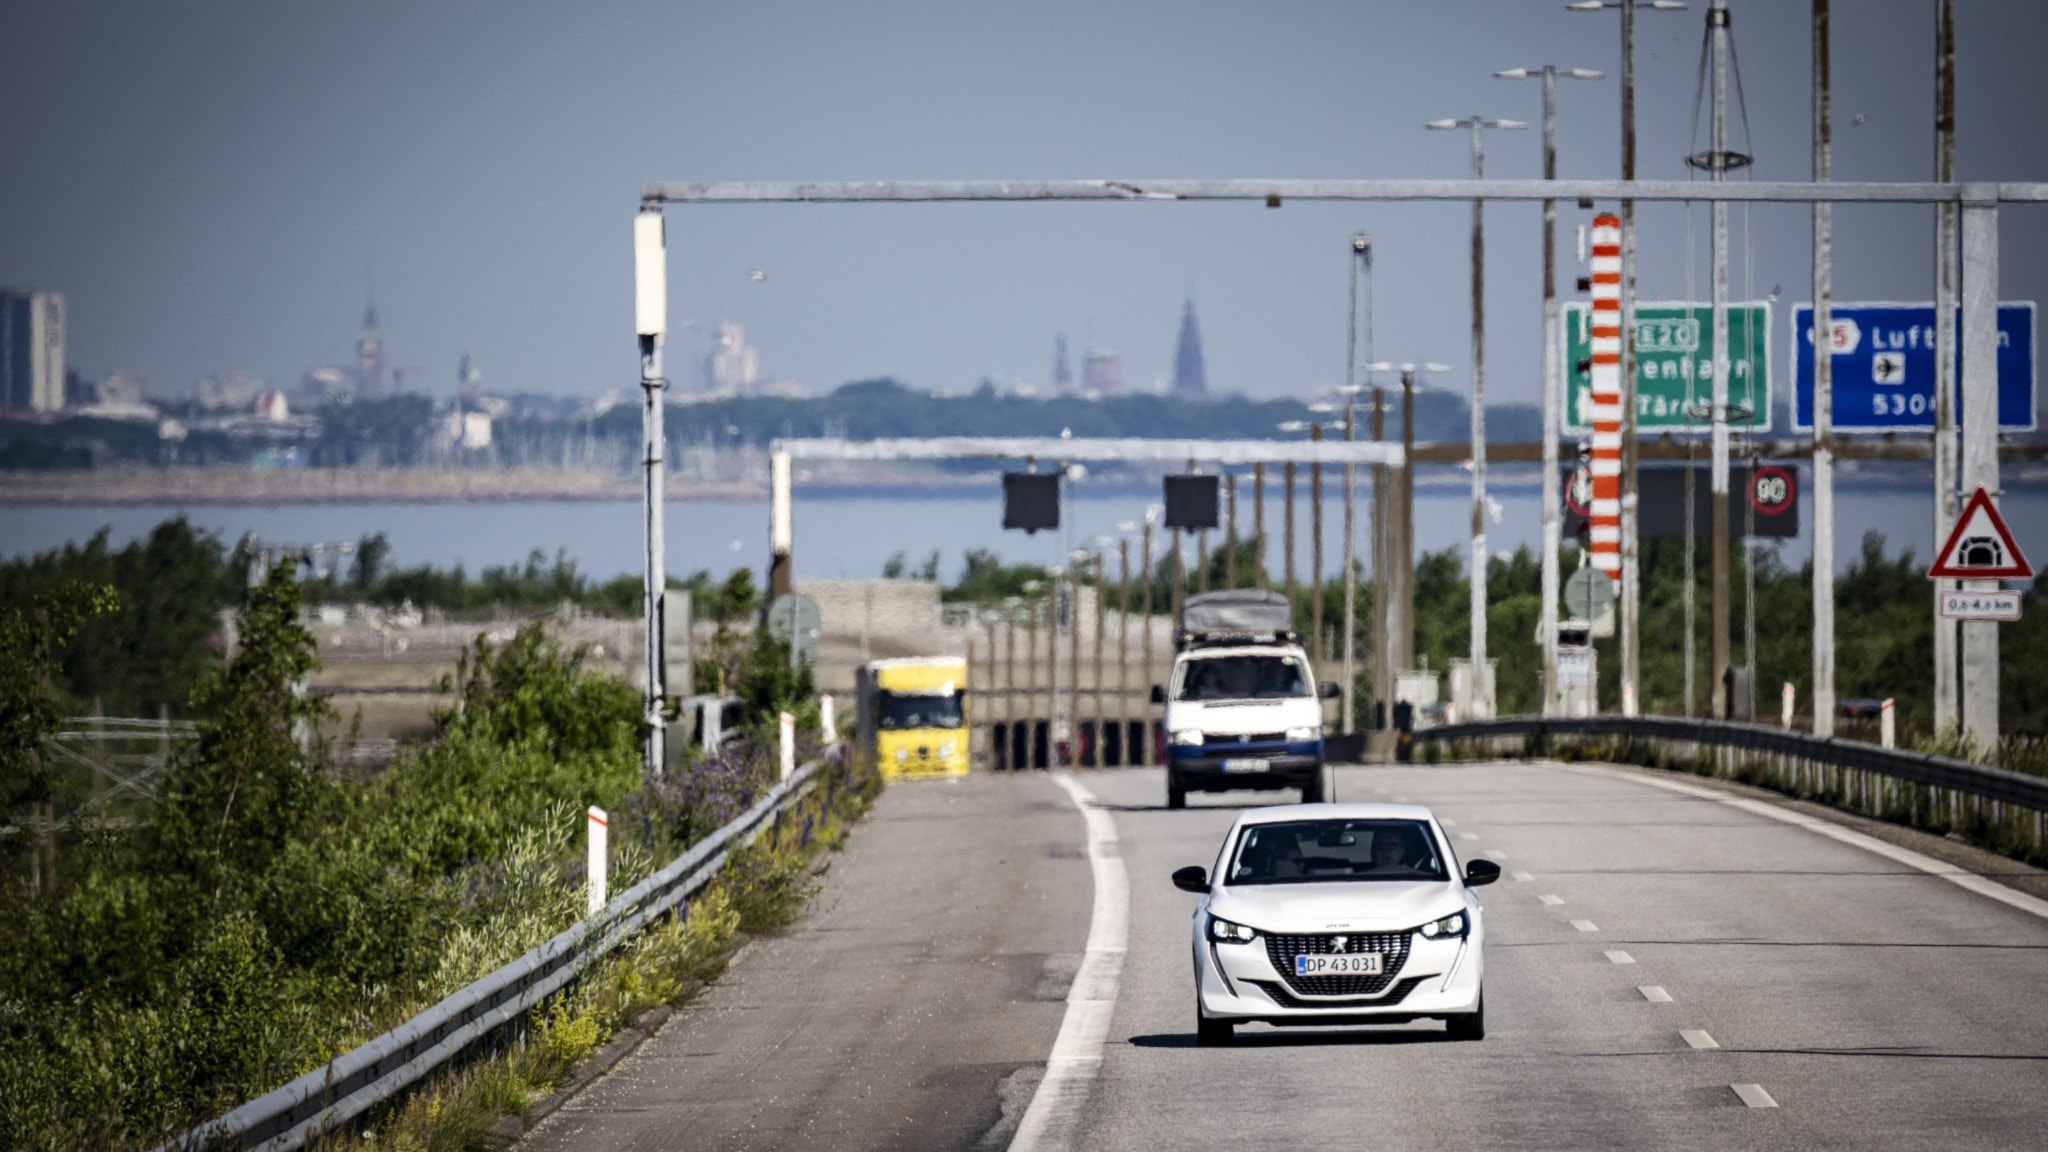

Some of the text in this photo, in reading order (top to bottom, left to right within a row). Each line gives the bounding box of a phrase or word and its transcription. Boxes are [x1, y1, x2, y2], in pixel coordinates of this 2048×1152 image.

[1641, 324, 1690, 345] E20
[1872, 325, 2010, 350] Luftn
[1307, 958, 1327, 972] DP
[1330, 958, 1348, 972] 43
[1351, 957, 1377, 971] 031
